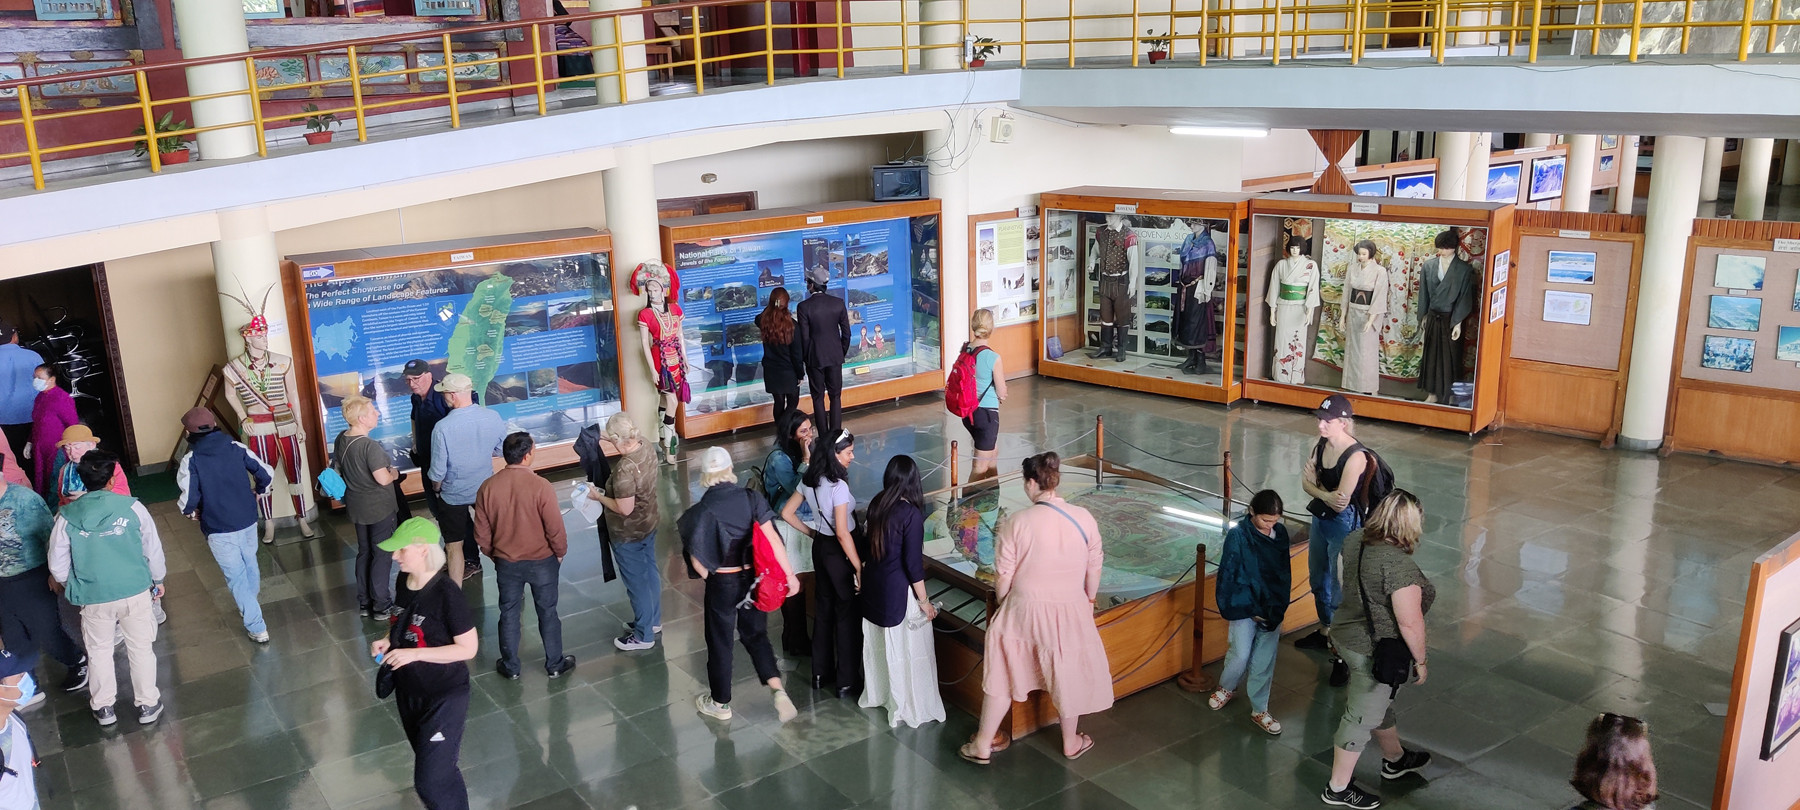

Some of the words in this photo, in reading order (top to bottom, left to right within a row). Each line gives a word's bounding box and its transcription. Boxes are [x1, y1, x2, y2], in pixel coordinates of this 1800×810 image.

[679, 250, 708, 260] National
[709, 247, 728, 256] Parks
[679, 259, 697, 267] Jewels
[305, 292, 320, 300] The
[321, 289, 350, 299] Perfect
[352, 284, 393, 294] Showcase
[393, 282, 405, 290] for
[313, 299, 333, 308] Wide
[335, 296, 361, 306] Range
[362, 294, 372, 302] of
[372, 290, 414, 301] Landscape
[415, 287, 449, 297] Features
